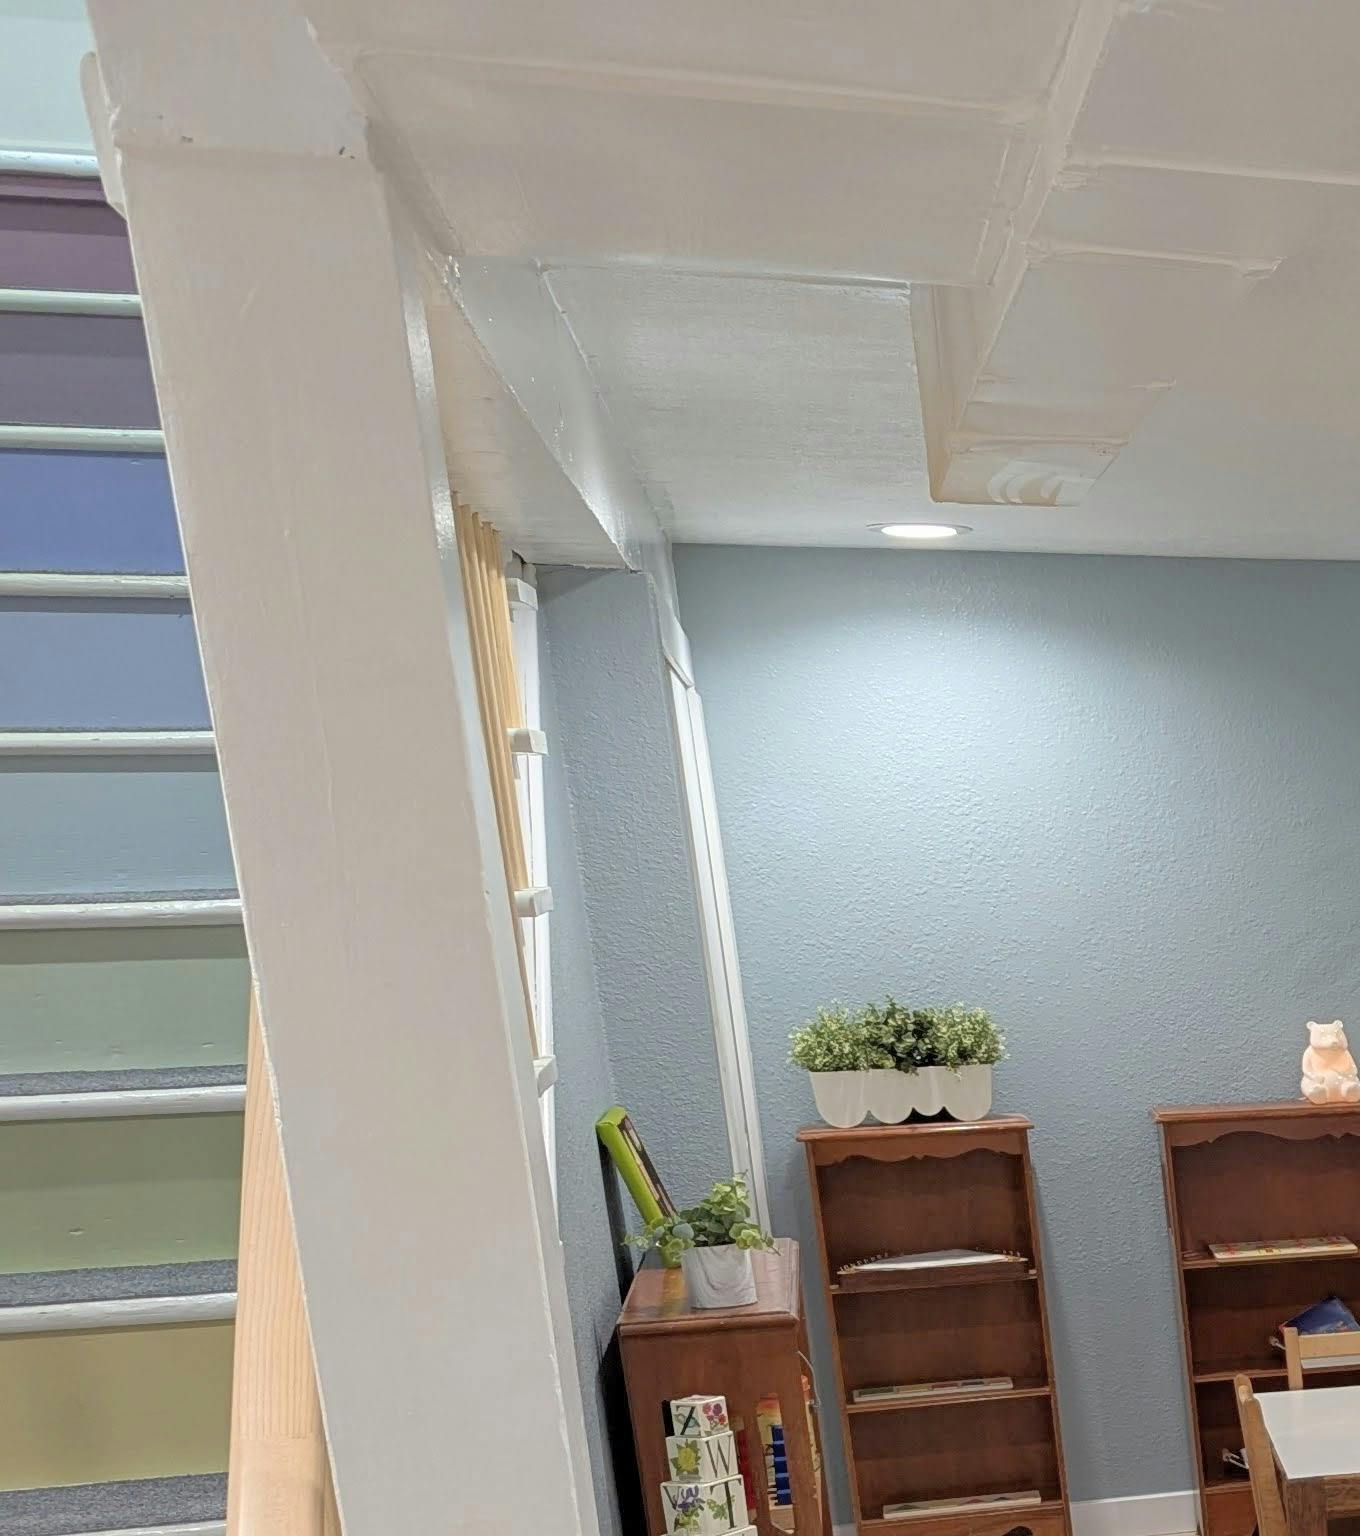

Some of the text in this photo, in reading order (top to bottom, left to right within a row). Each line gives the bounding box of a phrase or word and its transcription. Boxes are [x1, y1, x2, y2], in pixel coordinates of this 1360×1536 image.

[675, 1405, 701, 1437] Z
[705, 1434, 732, 1478] W
[709, 1478, 742, 1529] T
